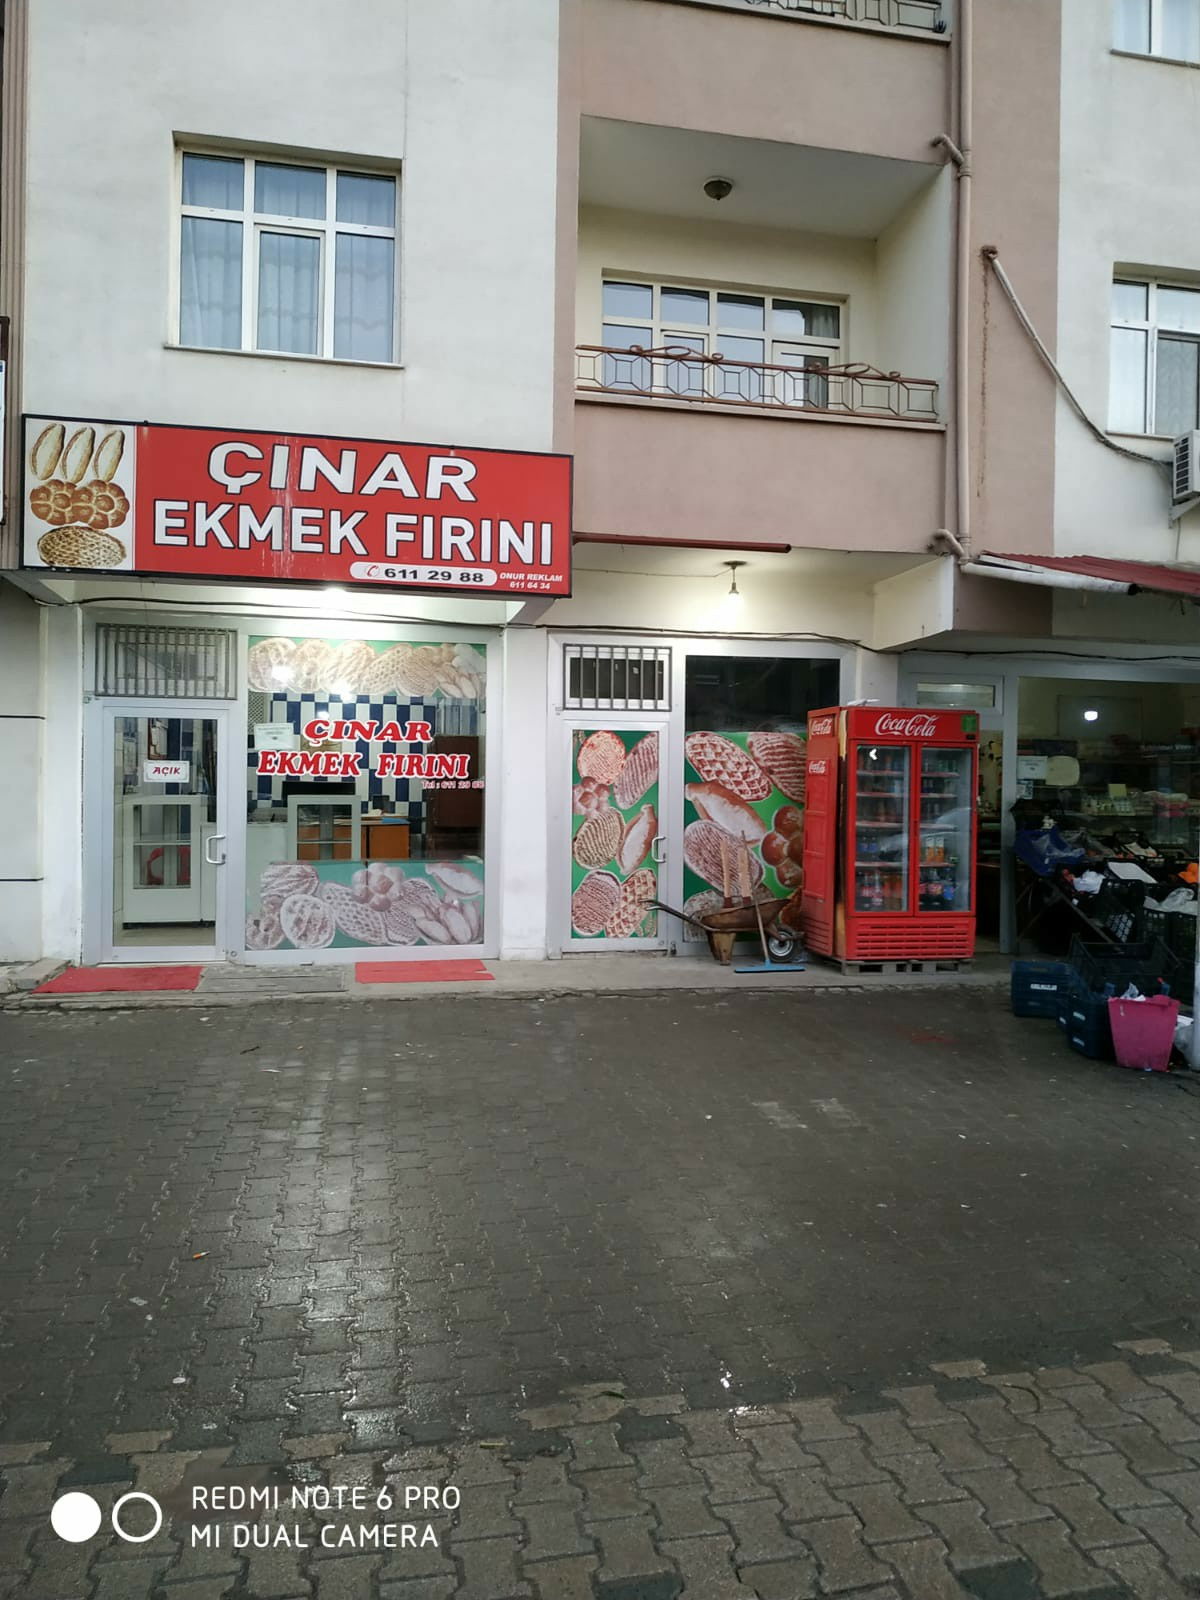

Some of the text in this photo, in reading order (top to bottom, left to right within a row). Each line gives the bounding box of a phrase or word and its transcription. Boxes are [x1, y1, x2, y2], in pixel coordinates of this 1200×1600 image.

[208, 441, 478, 502] ÇINAR
[154, 499, 552, 566] EKMEK FIRINI
[384, 568, 484, 583] 611 29 88
[499, 572, 563, 582] ONUR REKLAM
[509, 581, 525, 589] 611
[539, 582, 550, 590] 34
[304, 719, 434, 747] ÇINAR
[875, 713, 939, 736] Coca-Cola
[152, 766, 181, 776] AÇIK
[257, 750, 470, 779] EKMEK FIRINI
